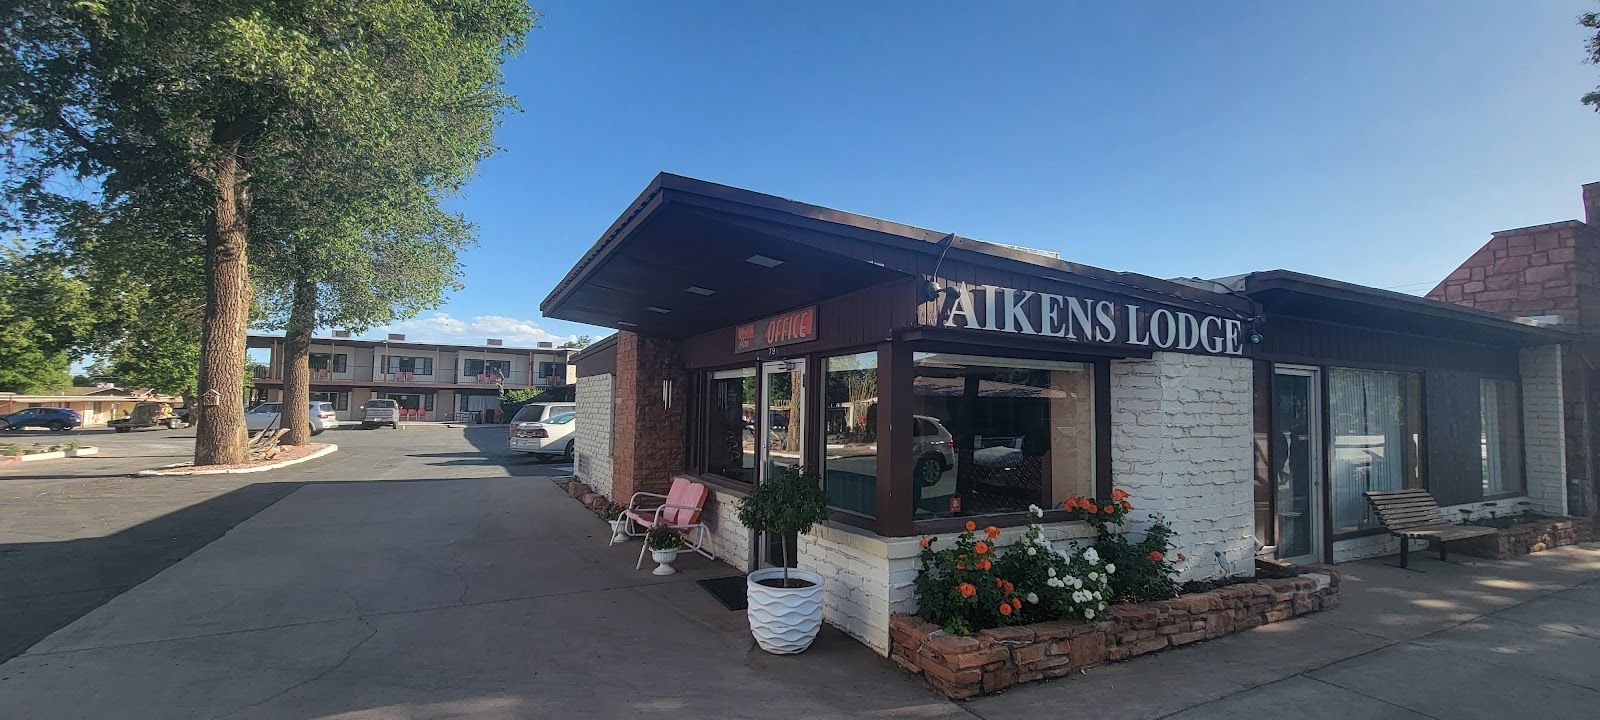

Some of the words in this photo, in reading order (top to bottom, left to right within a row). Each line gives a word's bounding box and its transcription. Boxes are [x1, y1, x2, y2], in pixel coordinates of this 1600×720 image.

[767, 312, 807, 344] OFFICE
[943, 281, 1116, 343] AIKENS
[1126, 304, 1243, 355] LODGE
